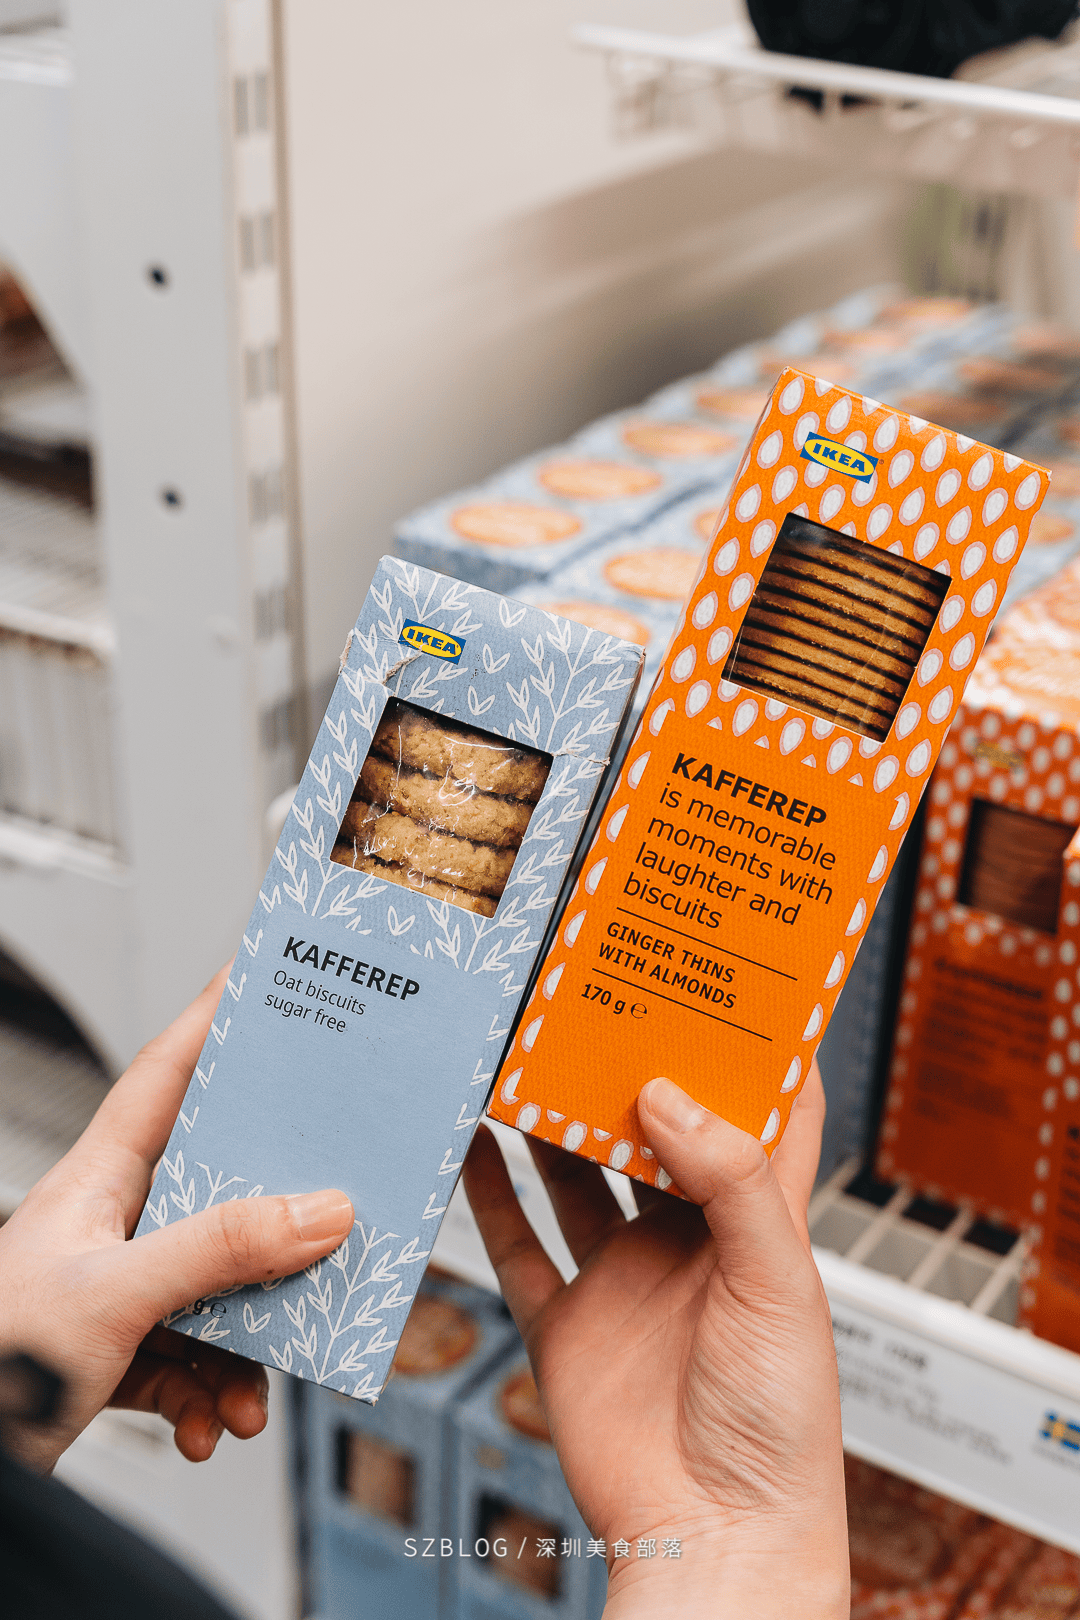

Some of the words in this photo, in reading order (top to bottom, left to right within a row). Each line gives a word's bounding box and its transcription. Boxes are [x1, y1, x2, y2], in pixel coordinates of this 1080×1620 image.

[812, 442, 865, 473] IKEA
[406, 628, 457, 655] IKEA
[671, 752, 827, 828] KAFFEREP
[659, 782, 682, 808] is
[687, 797, 836, 870] memorable
[635, 842, 746, 902] laughter
[749, 893, 801, 925] and
[647, 817, 773, 880] moments
[779, 868, 834, 904] with
[623, 872, 723, 929] biscuits
[282, 936, 420, 1001] KAFFEREP
[599, 942, 647, 973] WITH
[649, 964, 737, 1008] ALMONDS
[607, 922, 675, 960] GINGER
[681, 950, 736, 983] THINS
[264, 994, 312, 1018] sugar
[314, 1008, 346, 1033] free
[273, 970, 303, 993] Oat
[305, 980, 366, 1016] biscuits
[581, 983, 612, 1005] 170
[613, 999, 626, 1015] g
